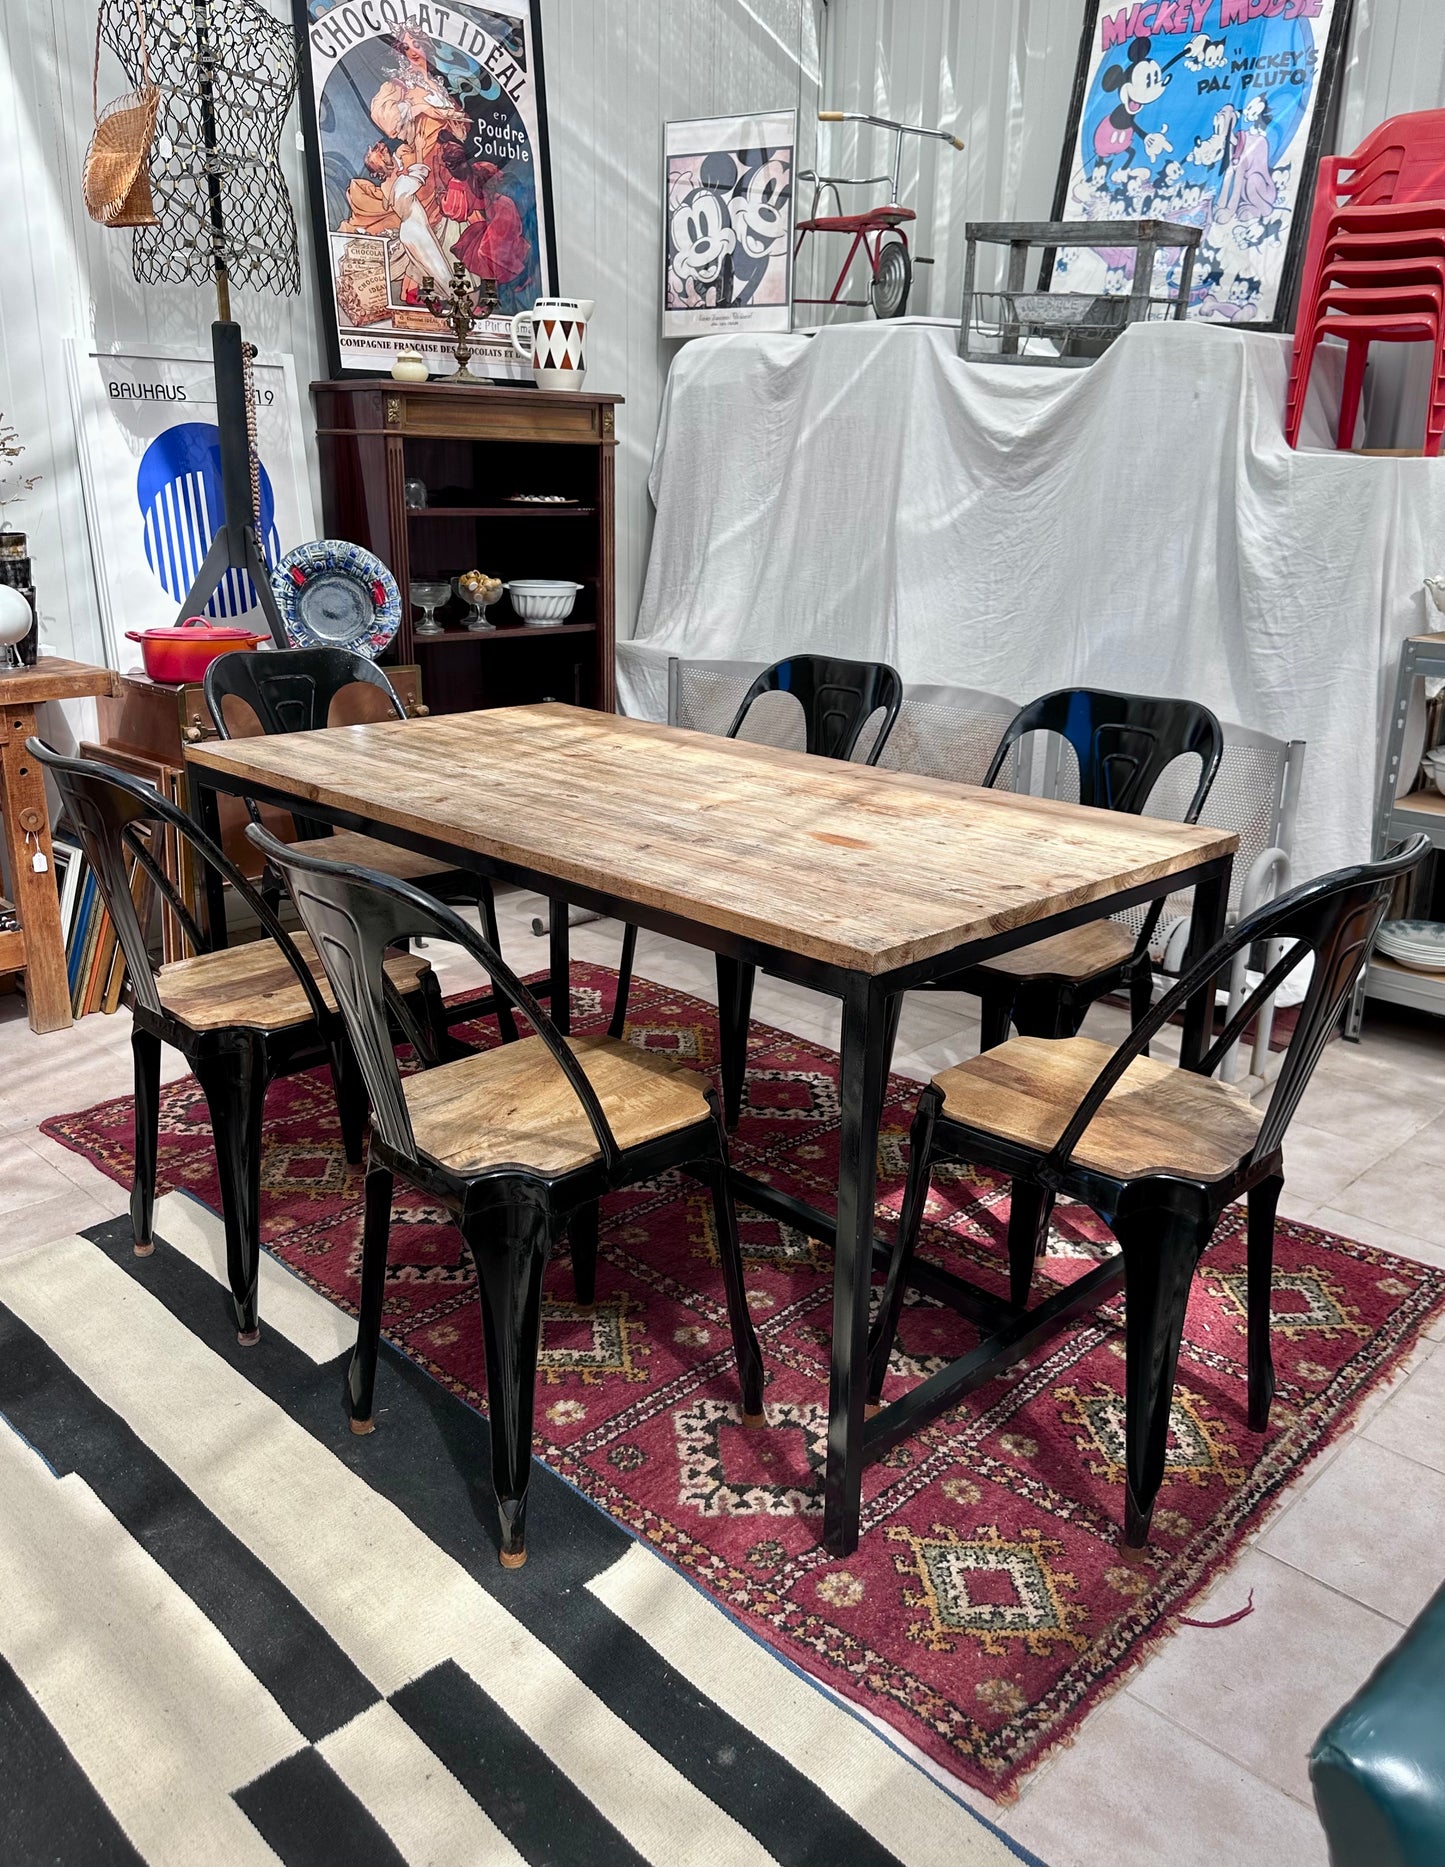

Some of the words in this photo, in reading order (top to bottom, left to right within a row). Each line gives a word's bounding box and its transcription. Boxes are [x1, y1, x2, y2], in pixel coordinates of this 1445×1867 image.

[311, 0, 449, 59] CHOCOLAT
[1102, 0, 1212, 51] MICKEY
[1220, 0, 1324, 29] MOUSE
[1197, 76, 1231, 95] PAL
[493, 111, 507, 121] en
[478, 119, 525, 143] Poudre
[473, 137, 529, 162] Soluble
[340, 338, 392, 350] COMPAGNIE
[440, 345, 456, 353] DES
[469, 347, 502, 358] OCOLATS
[504, 351, 514, 359] ET
[109, 382, 186, 400] BAUHAUS
